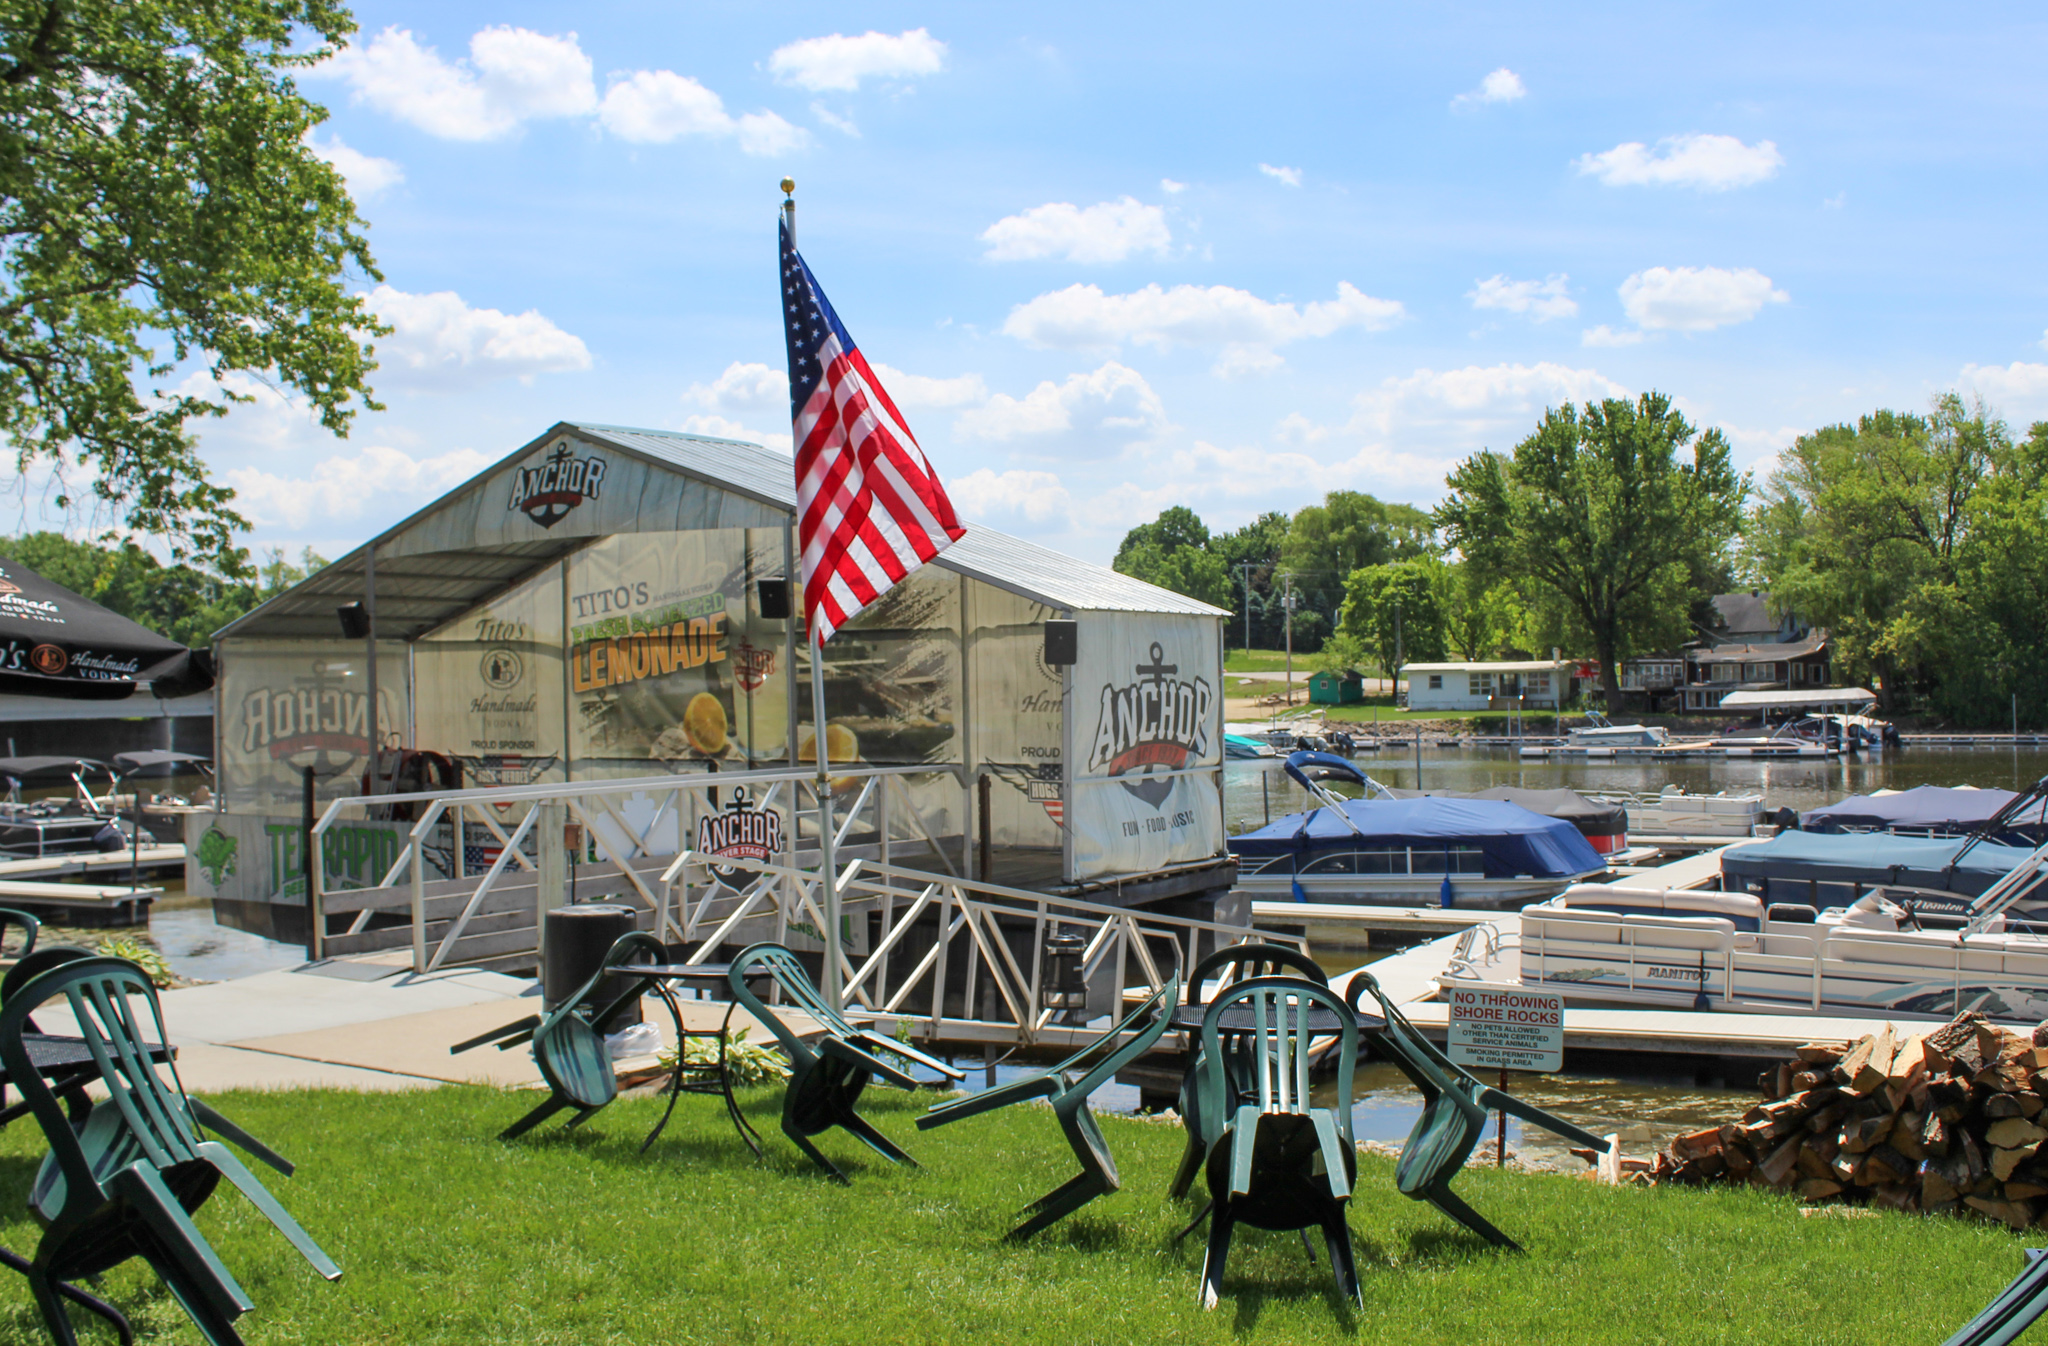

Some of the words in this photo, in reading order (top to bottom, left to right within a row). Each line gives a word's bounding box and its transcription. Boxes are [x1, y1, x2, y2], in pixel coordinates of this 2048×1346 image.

[508, 456, 607, 511] ANCHOR
[573, 582, 649, 618] TITO'S
[571, 615, 629, 645] FRESH
[631, 592, 726, 633] SQUEEZED
[475, 616, 527, 642] Tito's
[70, 651, 139, 673] Handmade
[573, 611, 728, 693] LEMONADE
[470, 693, 537, 713] Handmade
[1089, 676, 1212, 773] ANCHOR
[471, 740, 497, 749] PROUD
[499, 740, 536, 750] SPONSOR
[1021, 747, 1061, 758] PROUD
[1031, 783, 1060, 800] HOGS
[699, 808, 782, 855] ANCHOR
[1122, 821, 1140, 837] FUN
[1145, 816, 1167, 833] FOOD
[264, 824, 399, 896] TERAPIN
[740, 846, 766, 858] STAGE
[1647, 966, 1711, 982] MANITOU
[1455, 992, 1476, 1004] NO
[1480, 993, 1559, 1010] THROWING
[1453, 1005, 1503, 1020] SHORE
[1508, 1009, 1560, 1025] ROCKS
[1462, 1030, 1488, 1038] OTHER
[1489, 1031, 1510, 1039] THAN
[1510, 1033, 1549, 1043] CERTIFIED
[1471, 1023, 1483, 1031] NO
[1484, 1024, 1503, 1032] PETS
[1504, 1026, 1540, 1035] ALLOWED
[1472, 1037, 1504, 1046] SERVICE
[1505, 1040, 1539, 1049] ANIMALS
[1465, 1048, 1501, 1057] SMOKING
[1502, 1051, 1545, 1060] PERMITTED
[1476, 1055, 1485, 1063] IN
[1486, 1056, 1511, 1065] GRASS
[1512, 1058, 1533, 1067] AREA
